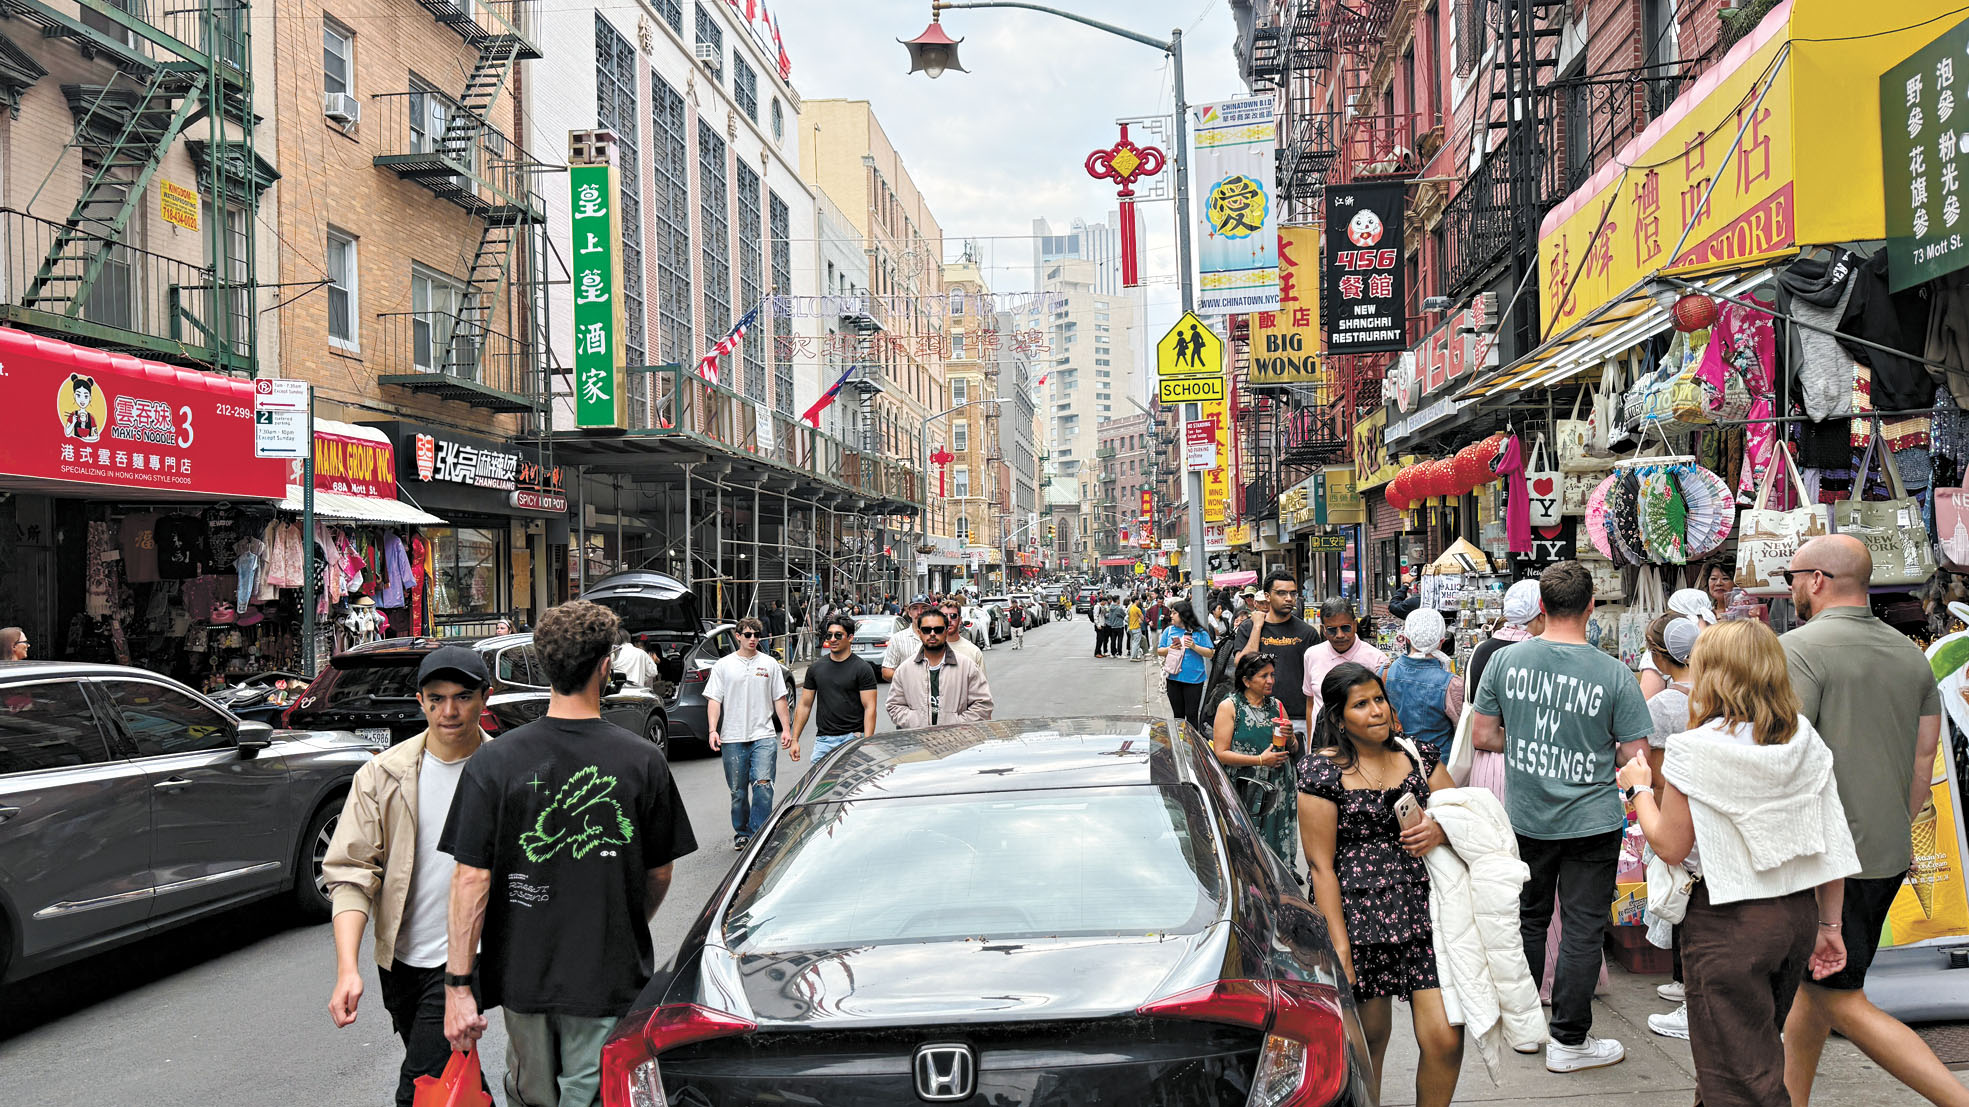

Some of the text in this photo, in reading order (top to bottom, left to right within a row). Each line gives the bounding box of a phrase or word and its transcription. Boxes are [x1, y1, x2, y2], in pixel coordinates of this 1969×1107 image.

[1222, 101, 1259, 111] CHINATOWN
[168, 183, 192, 200] KINGDOM
[1909, 146, 1929, 240] 花旗參
[1210, 175, 1262, 234] 愛
[1913, 233, 1964, 265] 73 Mott St.
[1335, 249, 1398, 271] 456
[1339, 273, 1394, 299] 餐館
[1201, 294, 1280, 309] WWW.CHINATOWN.NYC
[1354, 304, 1377, 315] NEW
[1339, 317, 1392, 330] SHANGHAI
[1266, 333, 1303, 353] BIG
[1333, 330, 1401, 344] RESTAURANT
[1414, 311, 1466, 397] 456
[1255, 356, 1317, 376] WONG
[1163, 382, 1221, 397] SCHOOL
[116, 397, 172, 431] 雲吞妹
[217, 404, 255, 419] 212-299-
[260, 411, 269, 424] 2
[112, 426, 177, 445] MAXI'S NOODLE
[178, 405, 194, 449] 3
[60, 442, 192, 474] 港式雲吞麵專門店
[315, 439, 345, 477] MAMA
[347, 443, 374, 481] GROUP
[376, 448, 393, 484] INC.
[60, 465, 107, 478] SPECIALIZING
[107, 470, 114, 478] IN
[115, 471, 134, 480] HONG
[134, 473, 153, 482] KONG
[171, 477, 192, 485] FOODS
[474, 476, 516, 491] ZHANGLIANG
[332, 481, 378, 495] 68A Mott St.
[1566, 482, 1600, 491] New Yor
[519, 493, 537, 506] SPICY
[1952, 492, 1969, 507] NE
[1530, 499, 1557, 518] Y
[1763, 541, 1794, 551] NEW
[1865, 534, 1895, 544] NEW
[1505, 667, 1604, 717] COUNTING
[334, 713, 405, 721] VOLVO
[1534, 706, 1561, 743] MY
[373, 733, 389, 743] 5986
[1506, 735, 1597, 783] LESSINGS
[1936, 852, 1947, 860] Yin
